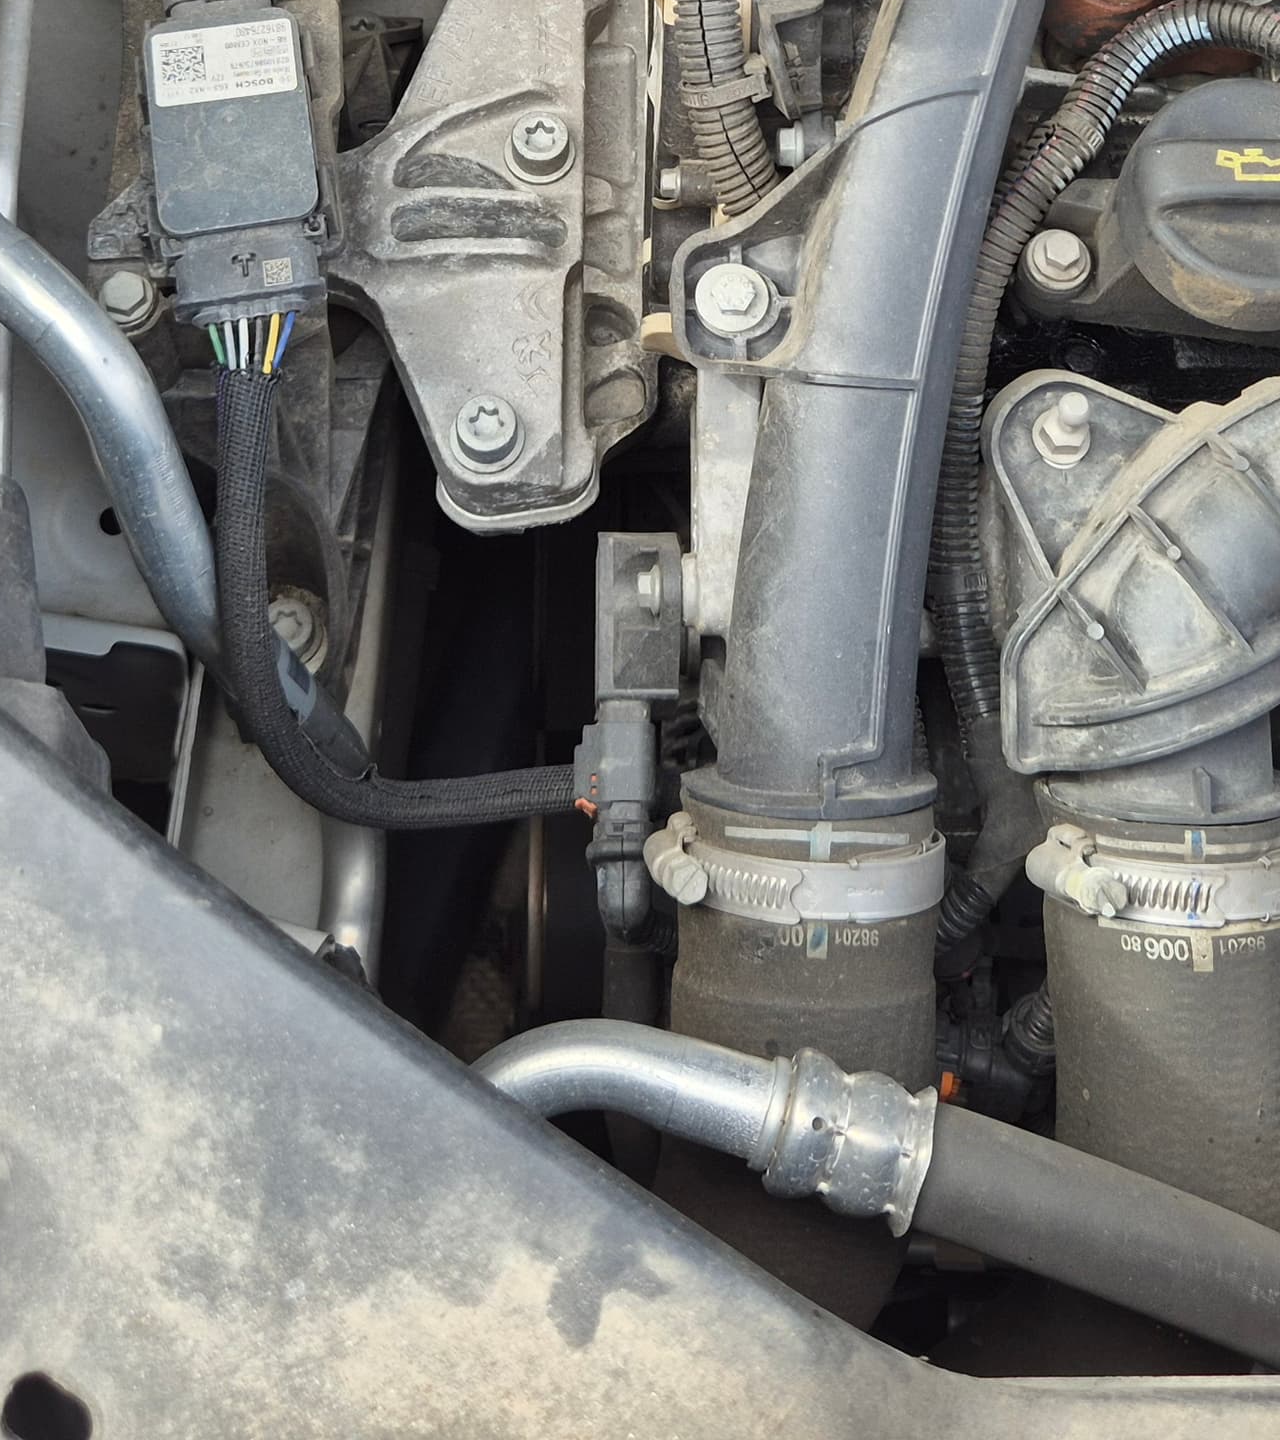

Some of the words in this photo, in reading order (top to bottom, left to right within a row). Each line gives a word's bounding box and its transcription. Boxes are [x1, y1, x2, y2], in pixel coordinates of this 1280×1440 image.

[234, 77, 274, 89] BOSCH
[834, 927, 880, 947] 98201
[1120, 933, 1142, 951] 80
[1218, 935, 1267, 956] 98201
[1143, 936, 1190, 961] 006
